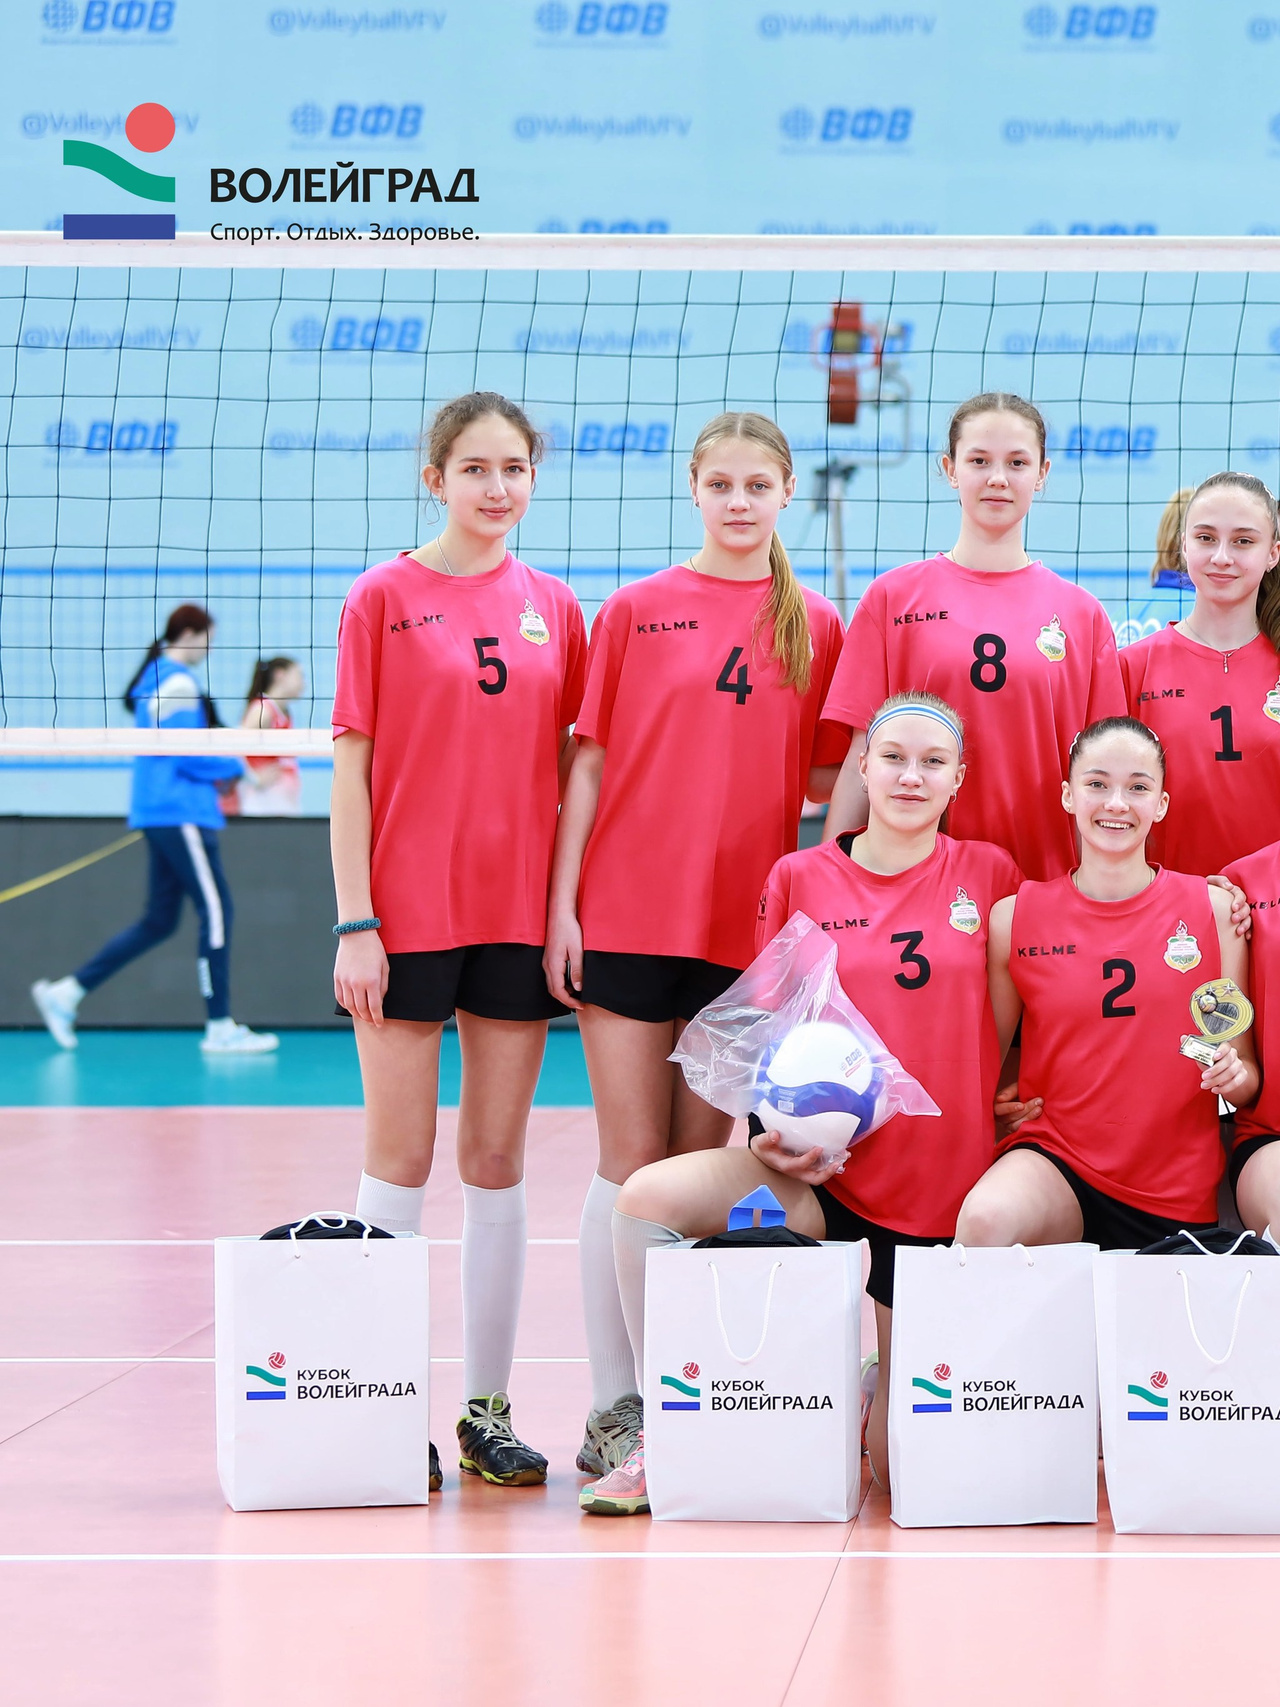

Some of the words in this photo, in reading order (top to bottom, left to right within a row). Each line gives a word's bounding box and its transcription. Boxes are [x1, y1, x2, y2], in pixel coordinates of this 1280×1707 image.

[389, 614, 446, 633] KELME
[636, 620, 699, 634] KELME
[893, 610, 948, 626] KELME
[474, 638, 507, 695] 5
[971, 634, 1006, 692] 8
[717, 647, 752, 704] 4
[1211, 706, 1242, 761] 1
[817, 917, 870, 931] ELME
[891, 931, 930, 989] 3
[1017, 944, 1077, 958] KELME
[1102, 959, 1135, 1017] 2
[298, 1369, 350, 1381] КУБОК
[297, 1380, 417, 1400] ВОЛЕЙГРАДА
[711, 1380, 765, 1392] КУБОК
[963, 1380, 1016, 1392] КУБОК
[711, 1392, 834, 1411] ВОЛЕЙГРАДА
[963, 1392, 1085, 1412] ВОЛЕЙГРАДА
[1179, 1390, 1233, 1402] КУБОК
